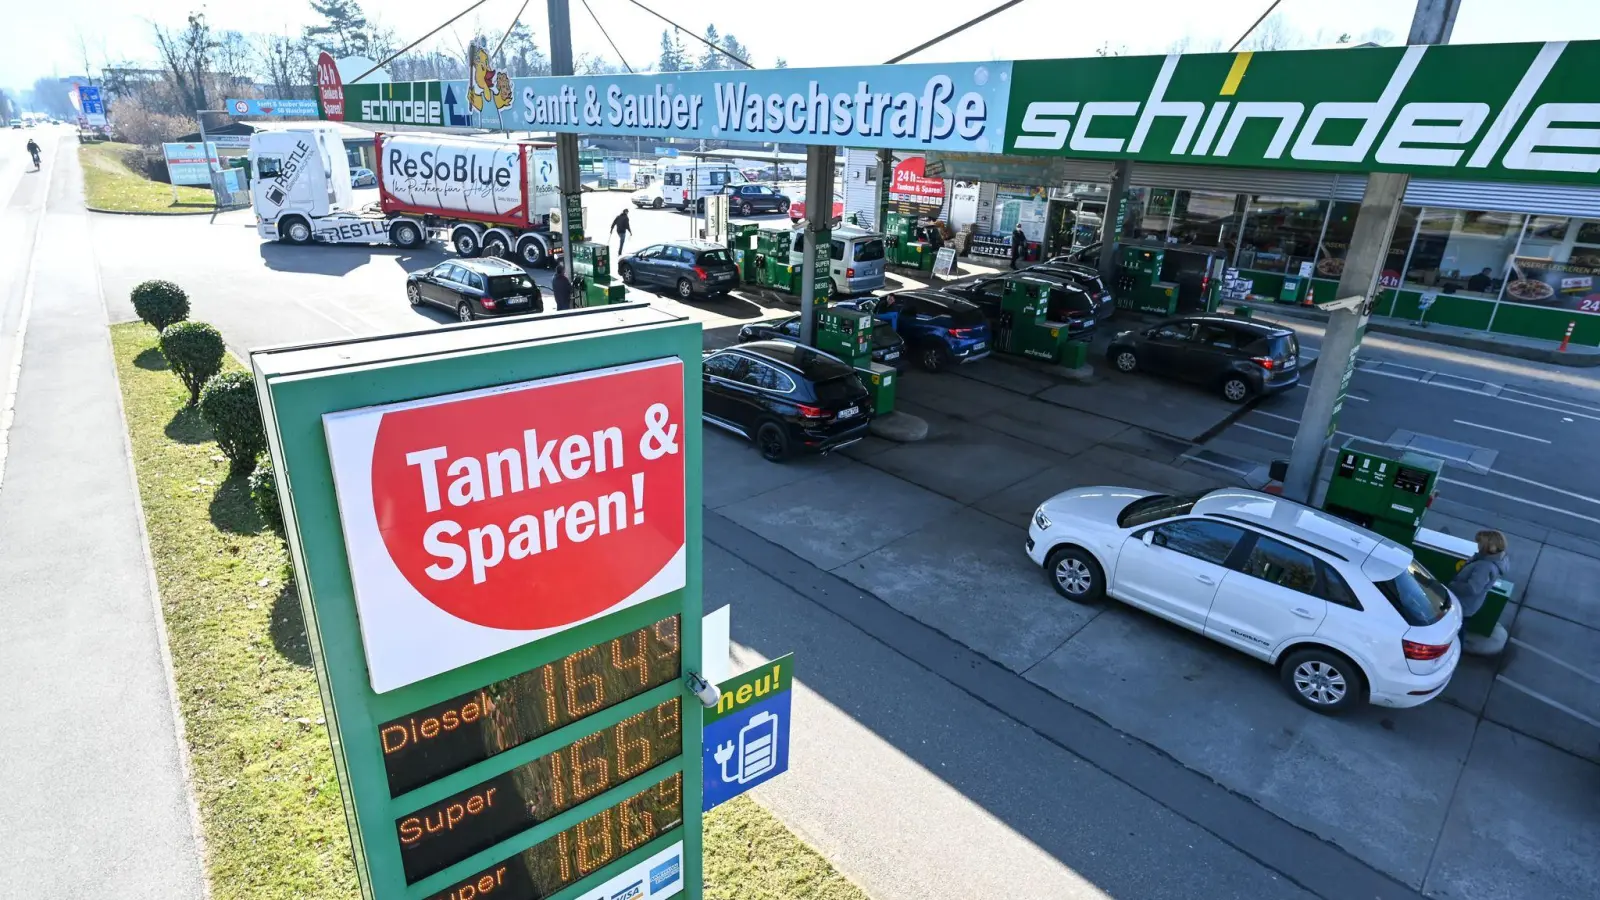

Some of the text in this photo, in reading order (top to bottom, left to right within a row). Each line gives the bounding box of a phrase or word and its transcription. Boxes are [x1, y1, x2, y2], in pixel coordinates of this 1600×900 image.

[318, 63, 336, 84] 24 h
[321, 87, 343, 99] Tanken &
[362, 82, 441, 124] schindele
[323, 101, 343, 114] Sparen!
[523, 74, 988, 143] Sanft & Sauber Waschstraße
[1014, 41, 1600, 173] schindele
[275, 140, 309, 188] RESTLE
[390, 148, 511, 187] ReSoBlue
[407, 177, 443, 195] Partner
[897, 170, 909, 182] 24
[910, 171, 916, 182] h
[897, 183, 915, 191] Tanken
[922, 185, 943, 194] Sparen!
[329, 220, 390, 241] RESTLE
[815, 282, 828, 290] DIESEL
[1390, 275, 1398, 286] h
[1581, 300, 1600, 311] 24
[405, 403, 679, 513] Tanken &
[423, 472, 645, 585] Sparen!
[717, 666, 781, 714] neu!
[381, 688, 492, 754] Diesel
[400, 785, 497, 844] Super
[616, 887, 640, 900] VISA
